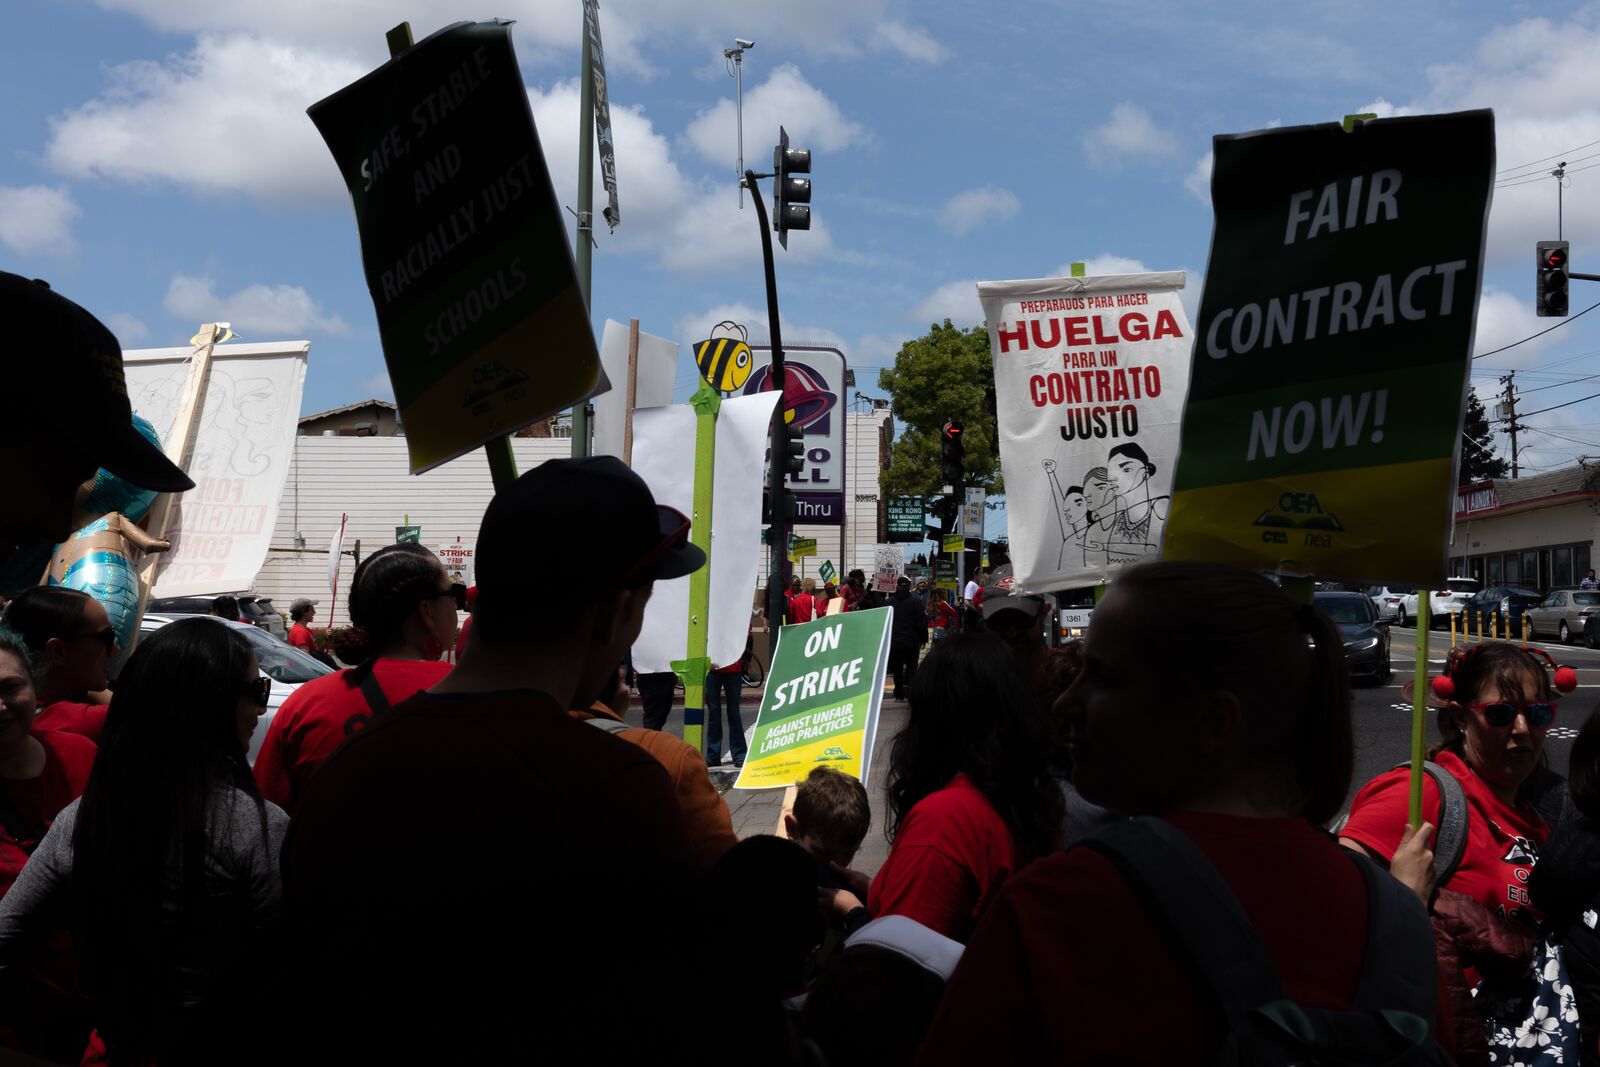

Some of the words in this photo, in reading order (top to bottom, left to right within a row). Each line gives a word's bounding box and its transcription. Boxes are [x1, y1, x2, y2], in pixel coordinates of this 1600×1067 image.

[360, 124, 410, 192] SAFE,
[411, 46, 492, 138] STABLE
[413, 144, 461, 205] AND
[1283, 167, 1403, 246] FAIR
[381, 200, 478, 304] RACIALLY
[482, 153, 534, 224] JUST
[424, 256, 528, 357] SCHOOLS
[1020, 297, 1085, 313] PREPARADOS
[1088, 295, 1114, 308] PARA
[1117, 293, 1148, 307] HACER
[1206, 259, 1467, 360] CONTRACT
[998, 309, 1184, 352] HUELGA
[1063, 352, 1097, 369] PARA
[1100, 351, 1118, 367] UN
[1030, 365, 1161, 407] CONTRATO
[1061, 404, 1138, 441] JUSTO
[1246, 389, 1389, 461] NOW!
[784, 468, 829, 482] LL
[796, 501, 832, 516] Thru
[1278, 492, 1324, 514] OEA
[804, 623, 842, 658] ON
[770, 657, 863, 711] STRIKE
[760, 733, 795, 753] LABOR
[796, 714, 854, 742] PRACTICES
[765, 715, 812, 740] AGAINST
[813, 703, 853, 725] UNFAIR
